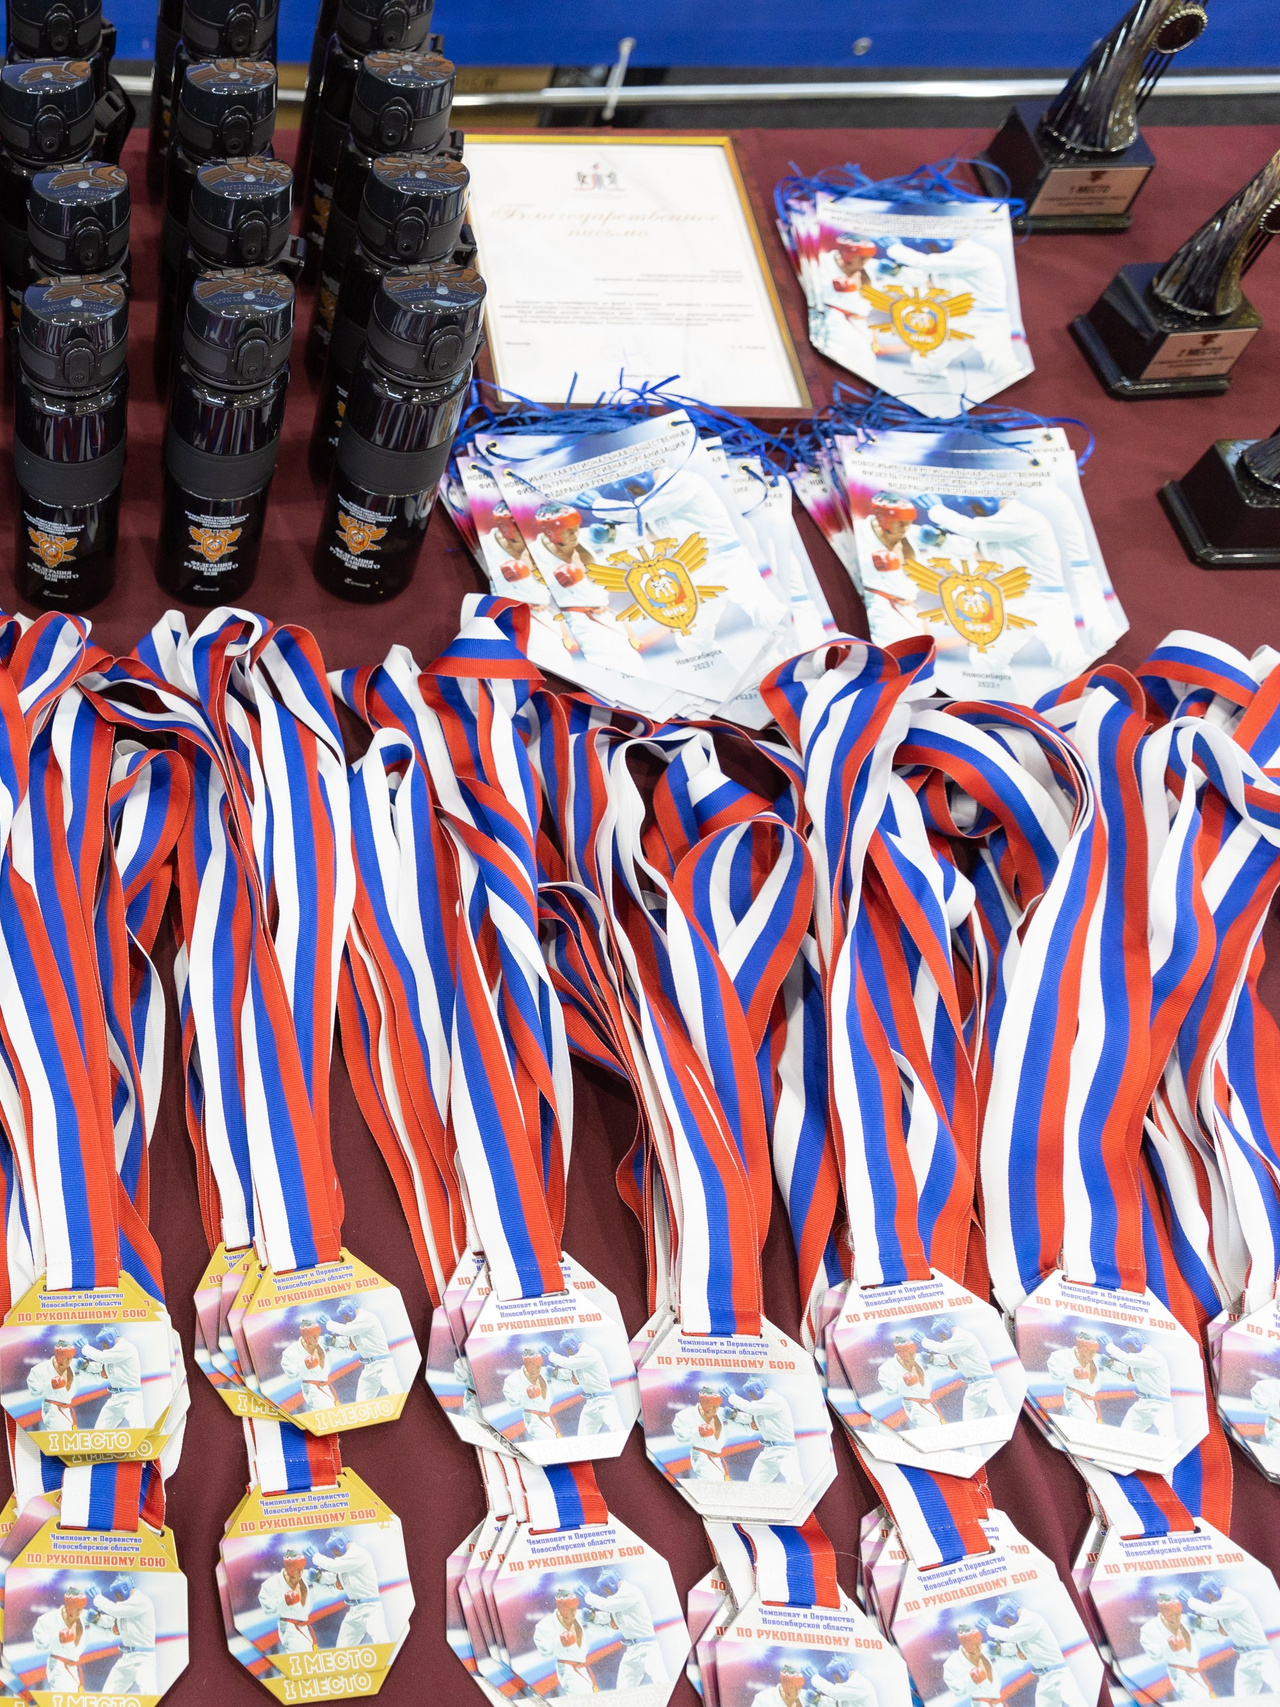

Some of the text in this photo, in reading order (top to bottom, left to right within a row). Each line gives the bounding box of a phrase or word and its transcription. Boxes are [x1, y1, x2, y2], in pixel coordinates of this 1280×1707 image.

[676, 649, 723, 665] Новосибирск
[694, 662, 709, 671] 2023
[257, 1277, 379, 1308] ПО РУКОПАШНОМУ БОЮ
[573, 1281, 596, 1290] БОЮ
[18, 1309, 147, 1321] ПО РУКОПАШНОМУ БОЮ
[845, 1296, 973, 1323] ПО РУКОПАШНОМУ БОЮ
[1036, 1295, 1176, 1331] ПО РУКОПАШНОМУ БОЮ
[480, 1313, 602, 1333] ПО РУКОПАШНОМУ БОЮ
[676, 1357, 764, 1368] РУКОПАШНОМУ
[769, 1361, 795, 1370] БОЮ
[329, 1402, 394, 1427] МЕСТО
[63, 1432, 131, 1451] МЕСТО
[259, 1499, 299, 1507] Чемпионат
[308, 1492, 349, 1502] Первенство
[240, 1509, 377, 1532] ПО РУКОПАШНОМУ БОЮ
[27, 1553, 166, 1567] ПО РУКОПАШНОМУ БОЮ
[509, 1546, 645, 1572] ПО РУКОПАШНОМУ БОЮ
[1104, 1553, 1244, 1574] ПО РУКОПАШНОМУ БОЮ
[904, 1569, 1038, 1612] ПО РУКОПАШНОМУ БОЮ
[737, 1627, 882, 1649] ПО РУКОПАШНОМУ БОЮ
[304, 1648, 376, 1674] МЕСТО
[299, 1672, 371, 1698] МЕСТО
